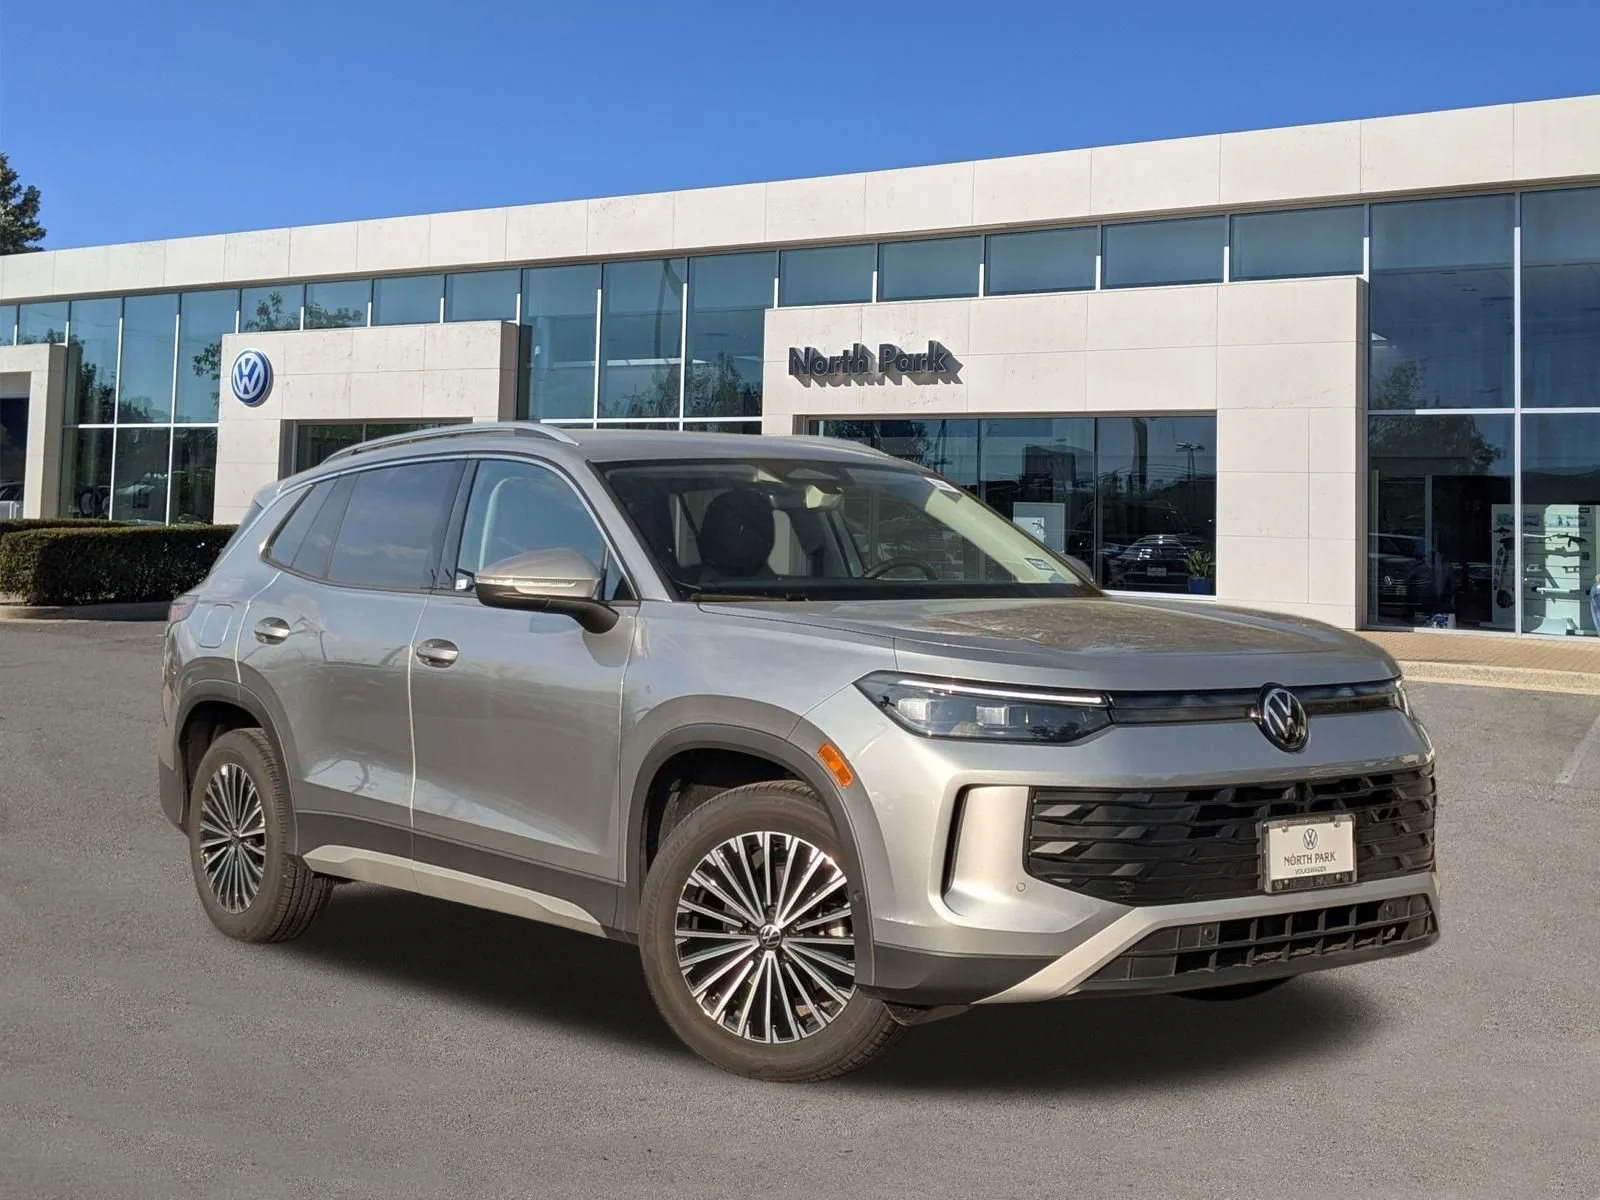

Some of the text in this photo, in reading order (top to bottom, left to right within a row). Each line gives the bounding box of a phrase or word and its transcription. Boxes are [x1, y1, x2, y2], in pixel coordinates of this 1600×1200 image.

[232, 351, 269, 403] VW
[788, 340, 947, 377] North Park
[1284, 851, 1336, 866] NORTH PARK
